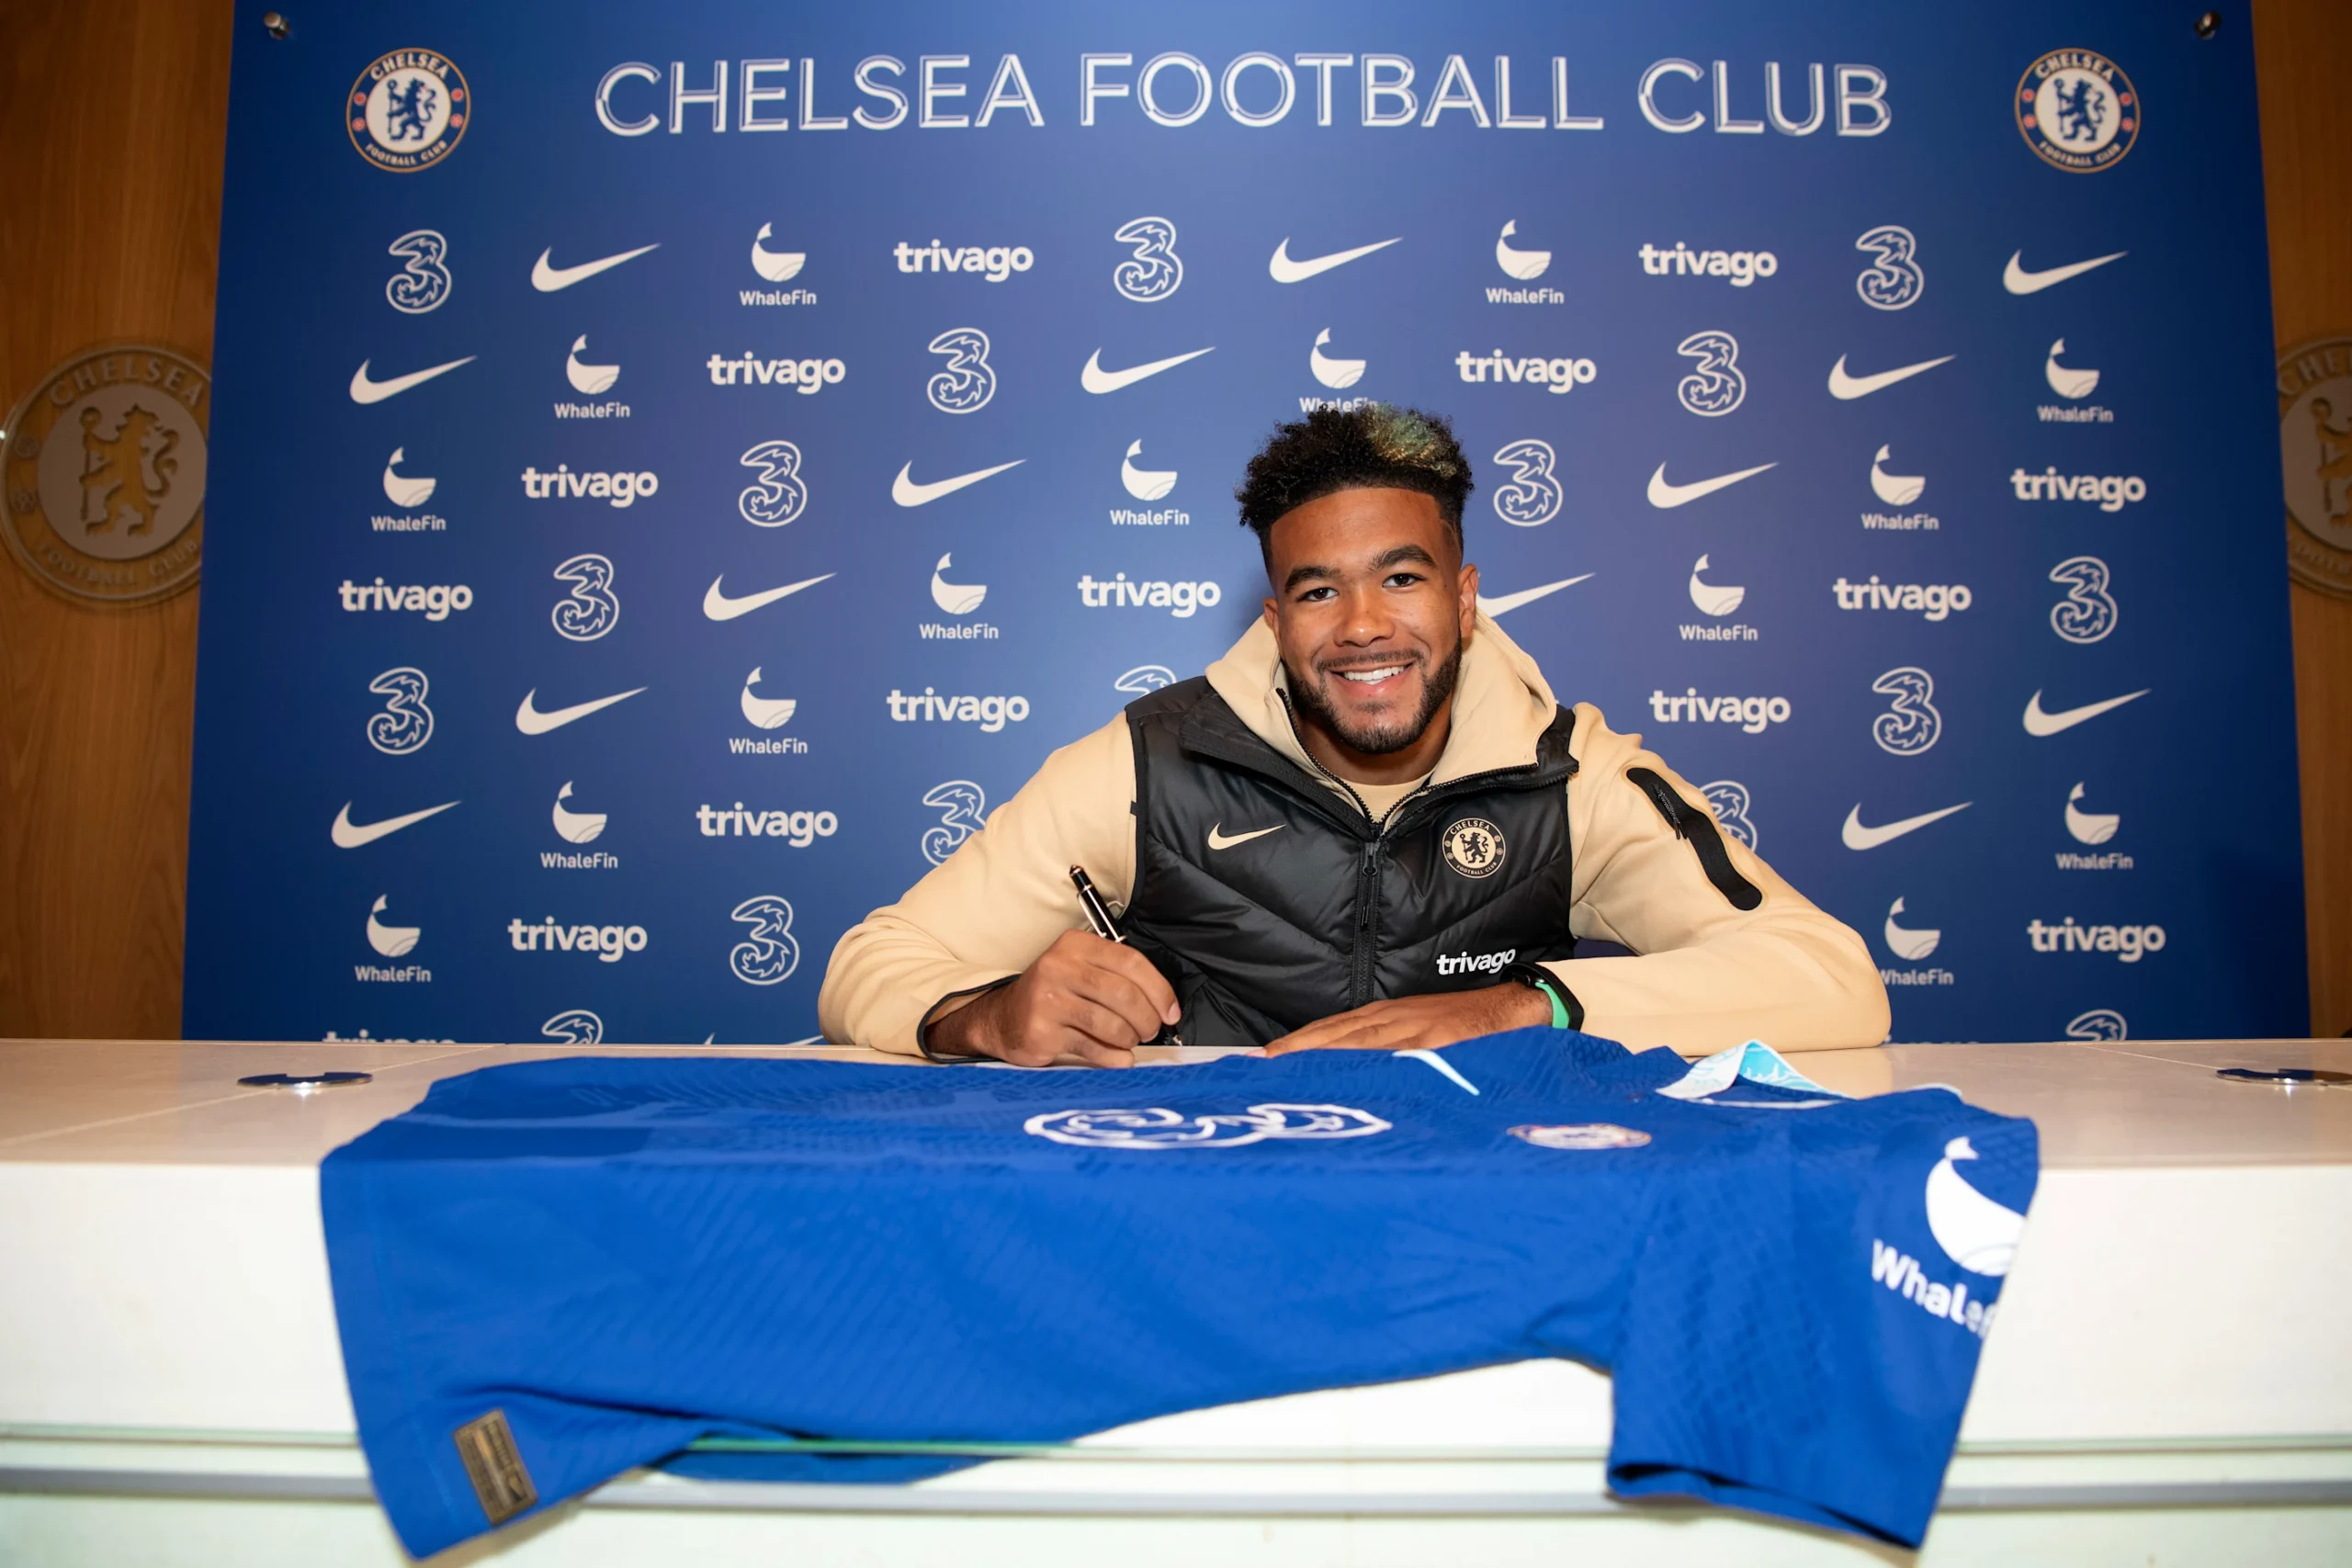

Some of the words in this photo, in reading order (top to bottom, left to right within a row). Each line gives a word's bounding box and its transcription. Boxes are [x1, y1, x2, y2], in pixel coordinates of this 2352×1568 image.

[370, 52, 449, 80] CHELSEA
[2034, 52, 2116, 82] CHELSEA
[596, 53, 1045, 136] CHELSEA
[1080, 51, 1603, 130] FOOTBALL
[1638, 59, 1890, 136] CLUB
[366, 142, 416, 165] FOOTBALL
[421, 140, 447, 163] CLUB
[2039, 141, 2092, 165] FOOTBALL
[2095, 142, 2121, 164] CLUB
[386, 230, 451, 313] 3
[894, 239, 1034, 282] trivago
[1114, 217, 1183, 302] 3
[1639, 242, 1777, 287] trivago
[1856, 226, 1924, 310] 3
[740, 289, 816, 305] WhaleFin
[1486, 288, 1564, 303] WhaleFin
[49, 356, 205, 407] CHELSEA
[707, 352, 845, 394] trivago
[927, 328, 996, 413] 3
[1455, 349, 1596, 393] trivago
[1678, 331, 1746, 416] 3
[2277, 344, 2352, 396] CHE
[555, 402, 630, 418] WhaleFin
[2038, 406, 2113, 422] WhaleFin
[522, 465, 658, 507] trivago
[739, 440, 807, 527] 3
[1494, 439, 1563, 526] 3
[2010, 467, 2146, 512] trivago
[371, 515, 446, 531] WhaleFin
[1110, 510, 1189, 525] WhaleFin
[1861, 513, 1939, 529] WhaleFin
[338, 578, 472, 621] trivago
[552, 554, 619, 641] 3
[1078, 572, 1221, 617] trivago
[1833, 576, 1971, 621] trivago
[2050, 557, 2118, 643] 3
[920, 624, 999, 639] WhaleFin
[1679, 625, 1758, 640] WhaleFin
[368, 667, 434, 754] 3
[887, 687, 1029, 732] trivago
[1649, 688, 1791, 733] trivago
[1872, 667, 1941, 755] 3
[729, 739, 808, 753] WhaleFin
[696, 802, 838, 847] trivago
[1450, 820, 1490, 835] CHELSEA
[541, 852, 617, 868] WhaleFin
[1456, 864, 1484, 875] FOOTBALL
[1485, 862, 1498, 873] CLUB
[2056, 853, 2133, 869] WhaleFin
[508, 917, 647, 962] trivago
[730, 896, 799, 985] 3
[2028, 917, 2165, 962] trivago
[355, 966, 431, 982] WhaleFin
[1436, 948, 1516, 976] trivago
[1880, 968, 1954, 986] WhaleFin
